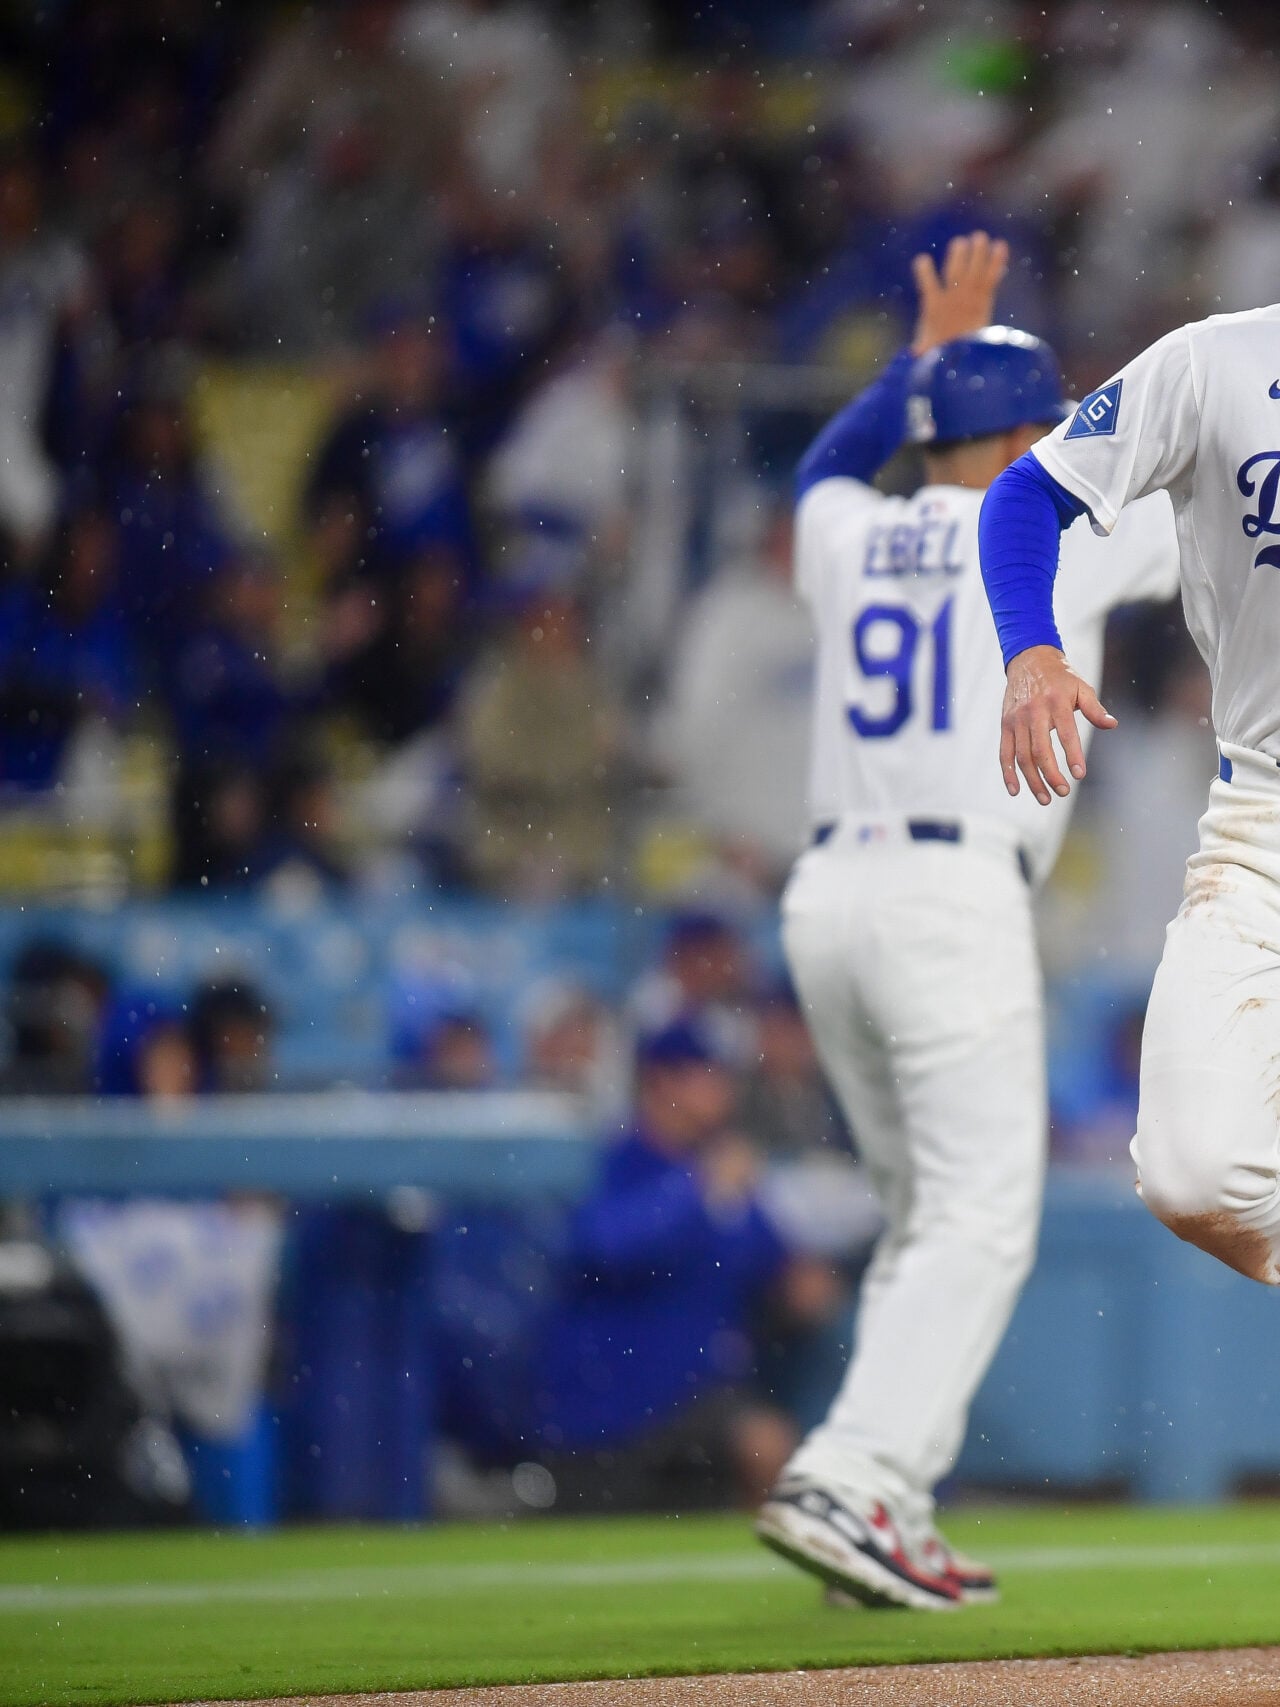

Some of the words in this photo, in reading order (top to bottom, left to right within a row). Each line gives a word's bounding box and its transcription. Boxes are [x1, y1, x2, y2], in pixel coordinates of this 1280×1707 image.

[1087, 393, 1113, 421] G
[863, 520, 963, 577] EBEL
[847, 595, 955, 738] 91
